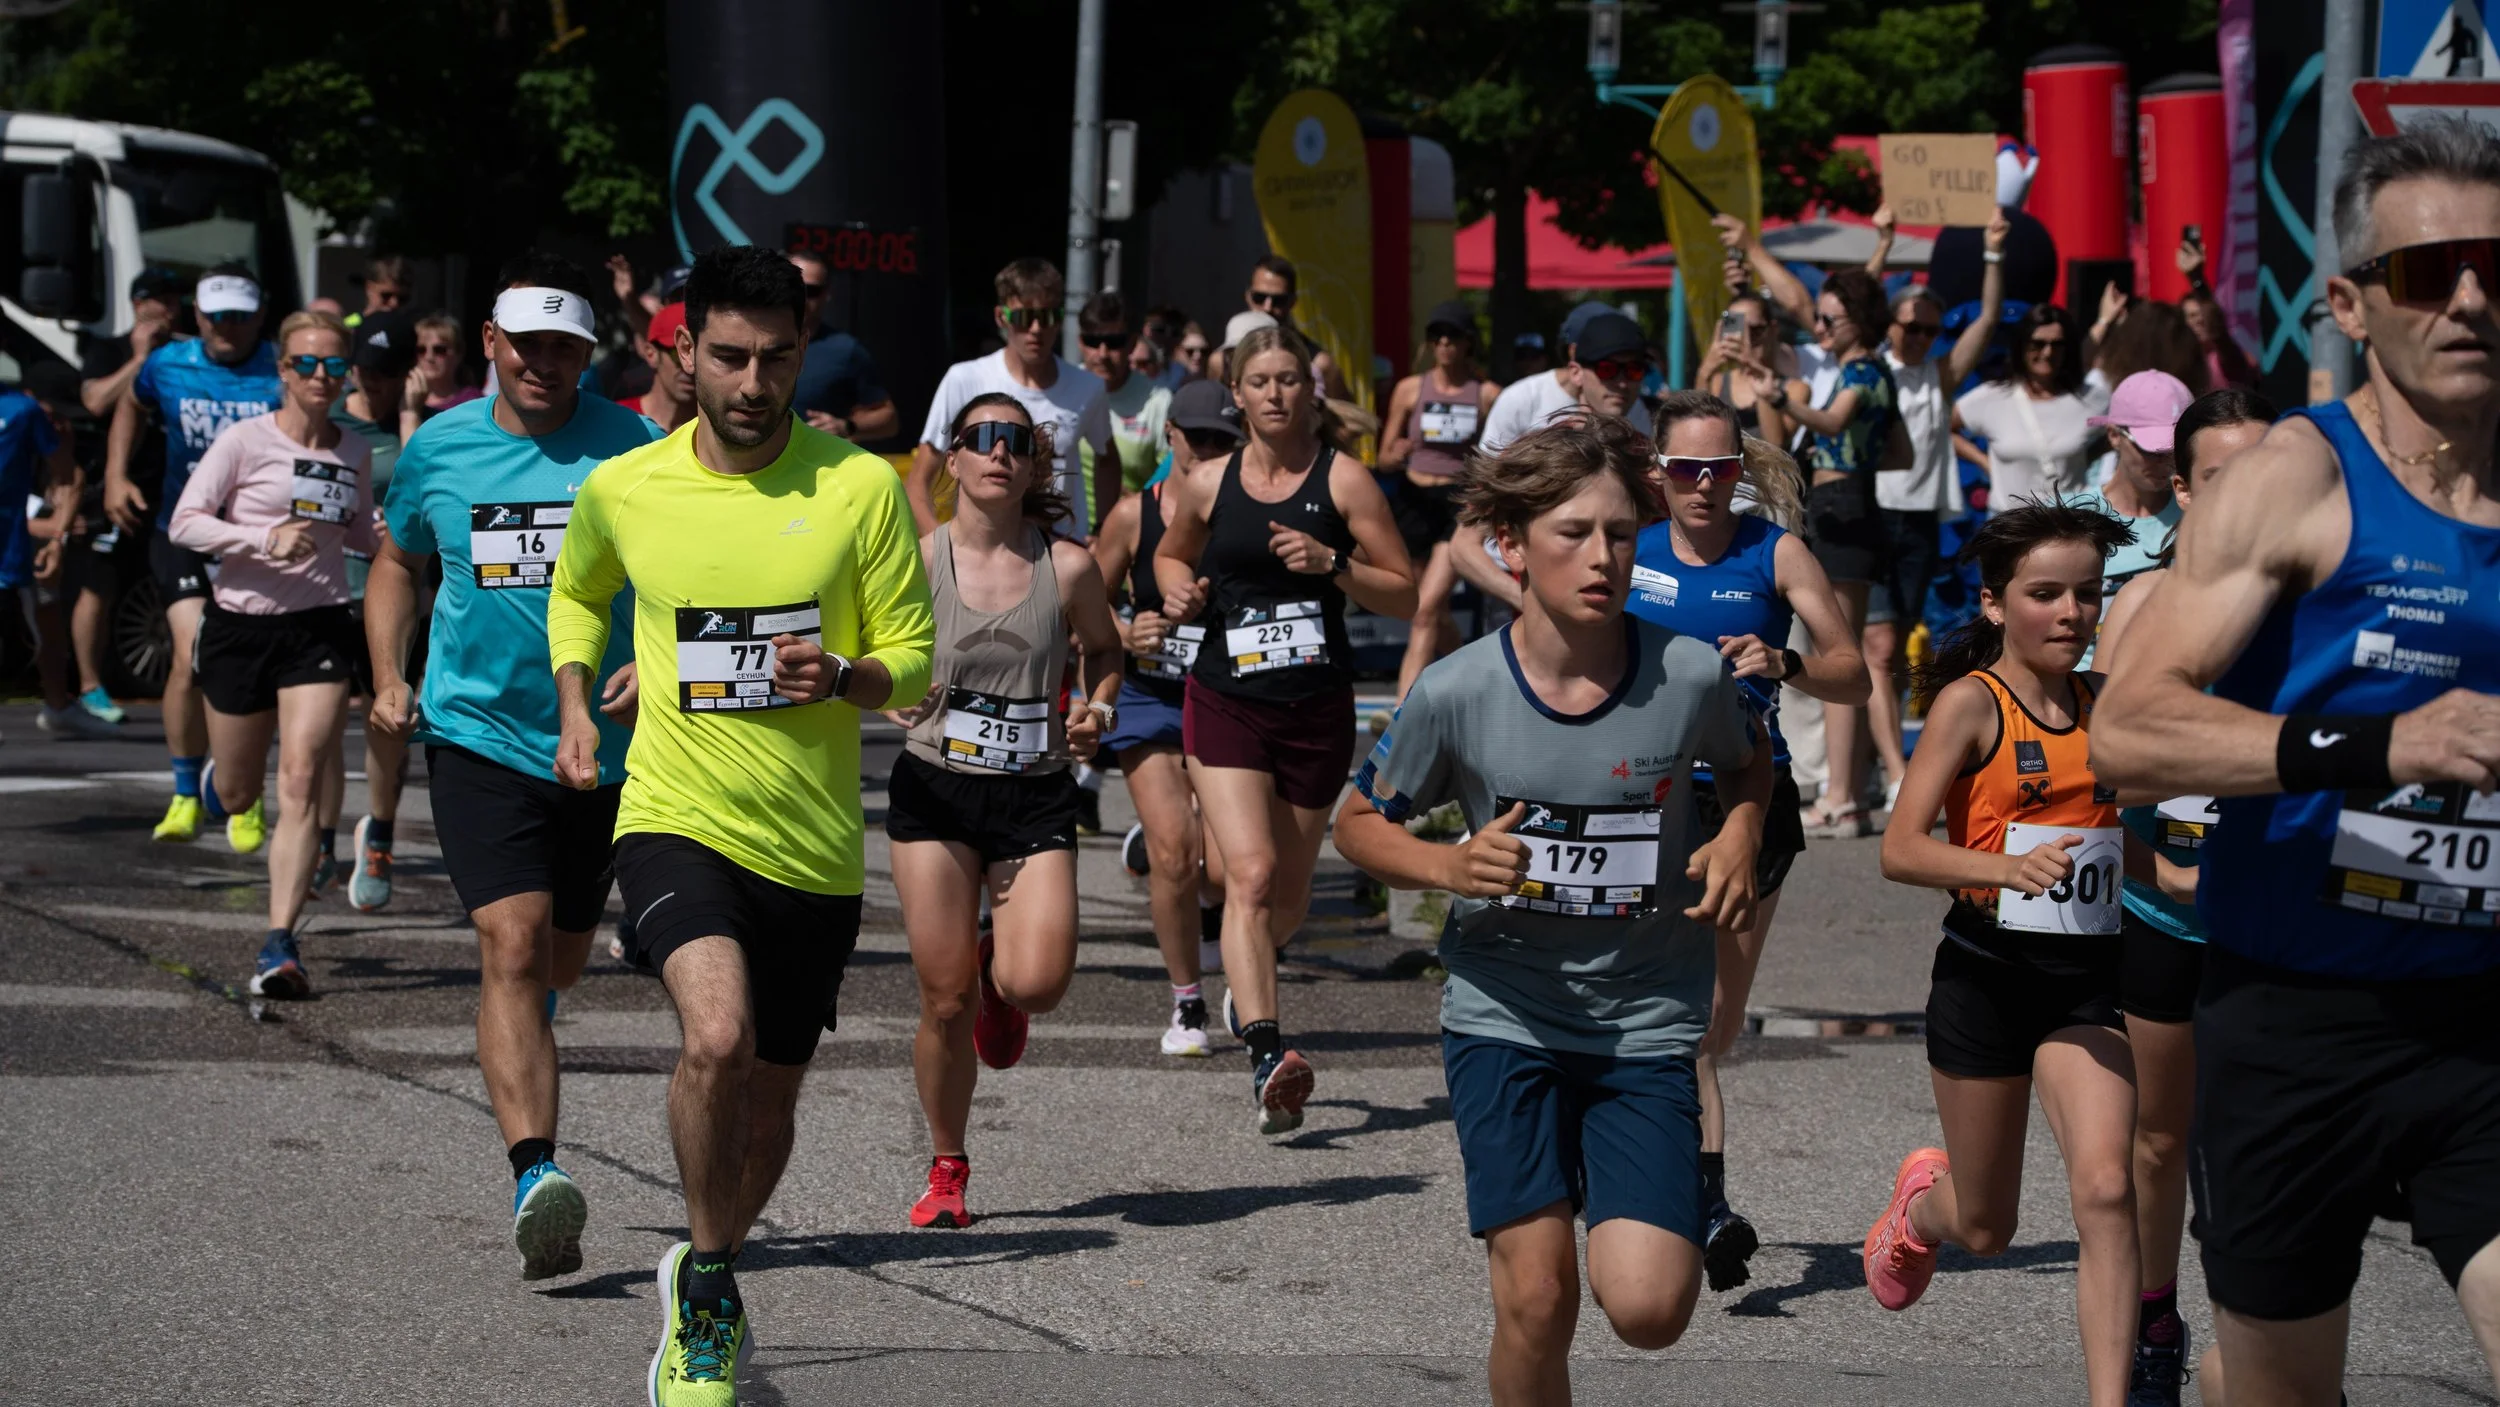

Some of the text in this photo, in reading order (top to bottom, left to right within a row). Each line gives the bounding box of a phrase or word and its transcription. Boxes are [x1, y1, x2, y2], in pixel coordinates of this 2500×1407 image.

[1893, 144, 1927, 166] GO
[180, 398, 270, 419] KELTEN
[323, 484, 342, 500] 26
[517, 533, 545, 555] 16
[1640, 591, 1676, 608] VERENA
[2387, 604, 2445, 624] THOMAS
[1257, 624, 1294, 645] 229
[730, 644, 768, 671] 77
[2394, 647, 2461, 668] BUSINESS
[736, 672, 766, 680] CEYHUN
[2392, 660, 2457, 680] SOFTWARE
[978, 719, 1020, 744] 215
[1634, 757, 1650, 768] Ski
[2020, 759, 2044, 767] ORTHO
[1623, 792, 1651, 803] Sport
[1546, 844, 1608, 875] 179
[2406, 828, 2490, 872] 210
